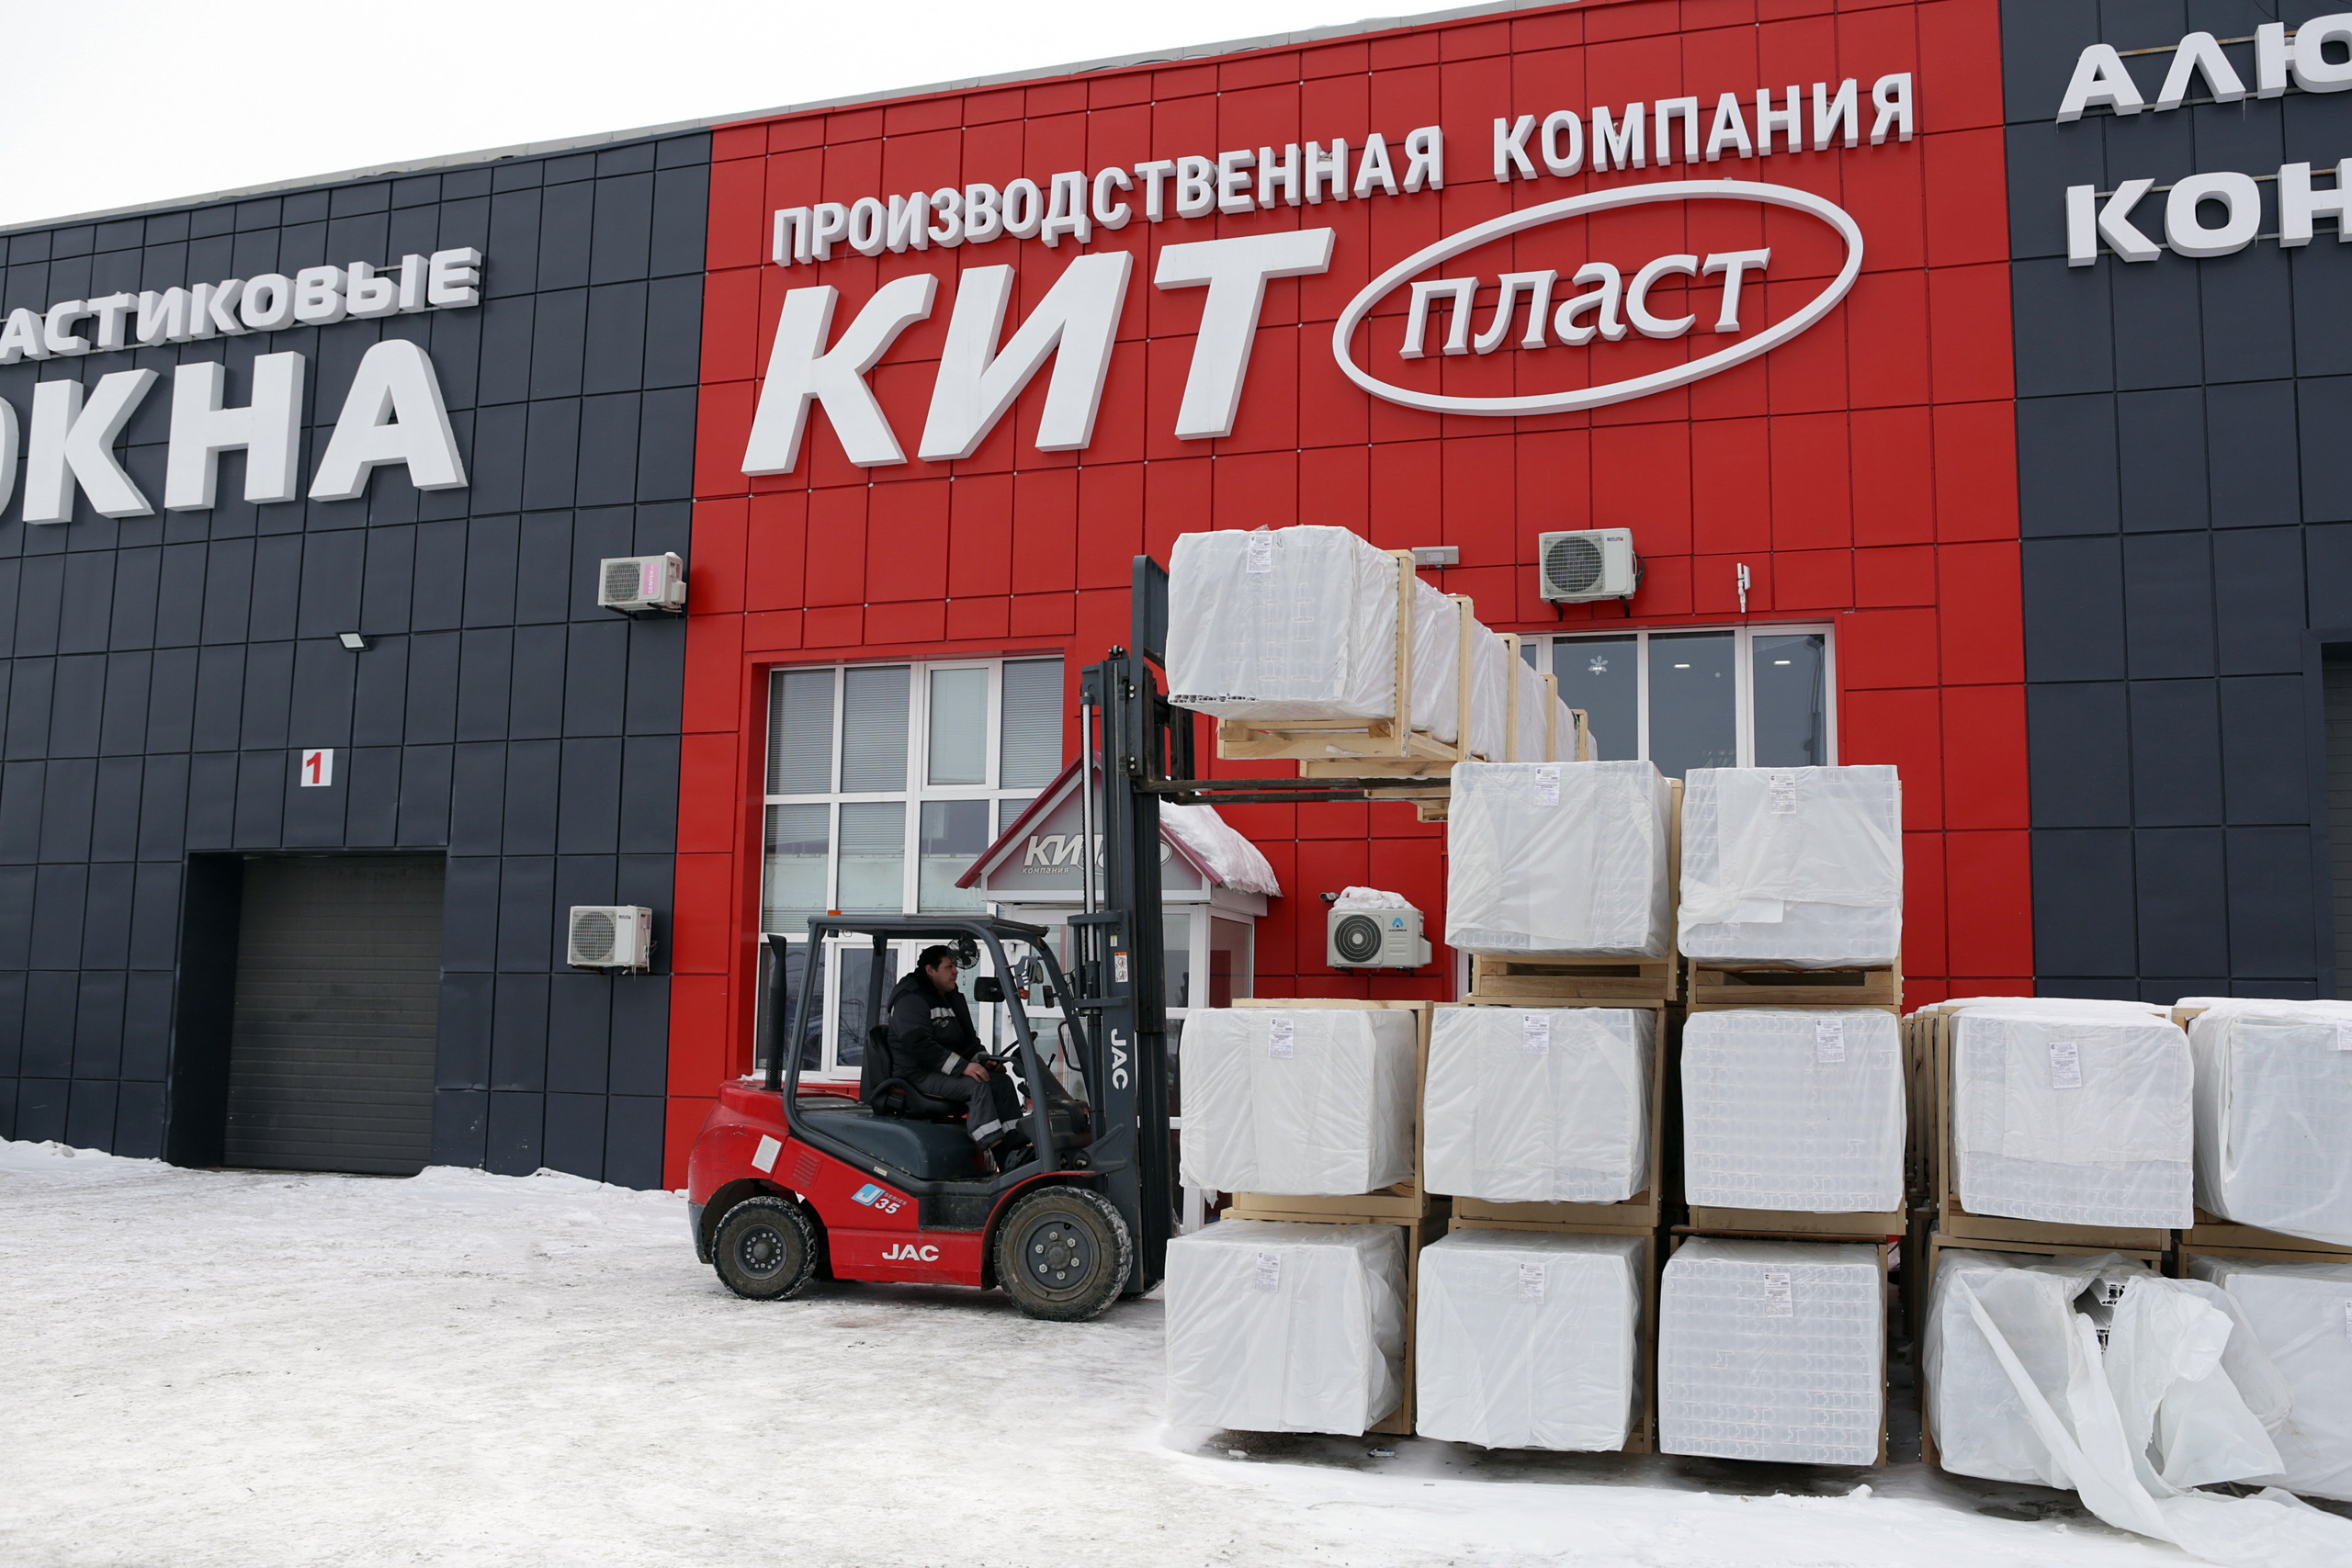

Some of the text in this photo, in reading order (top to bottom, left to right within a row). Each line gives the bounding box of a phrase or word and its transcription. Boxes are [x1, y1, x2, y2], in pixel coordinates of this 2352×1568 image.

[2055, 12, 2352, 123] АЛЮ
[772, 73, 1913, 266] ПРОИЗВОДСТВЕННАЯ КОМПАНИЯ
[2065, 157, 2352, 267] КОН
[0, 247, 481, 364] АСТИКОВЫЕ
[741, 227, 1771, 476] КИТ пласт
[0, 339, 468, 525] КНА
[307, 752, 322, 784] 1
[1110, 1028, 1129, 1090] JAC
[874, 1198, 900, 1214] 35
[881, 1243, 940, 1262] JAC
[883, 1192, 908, 1206] SERIES
